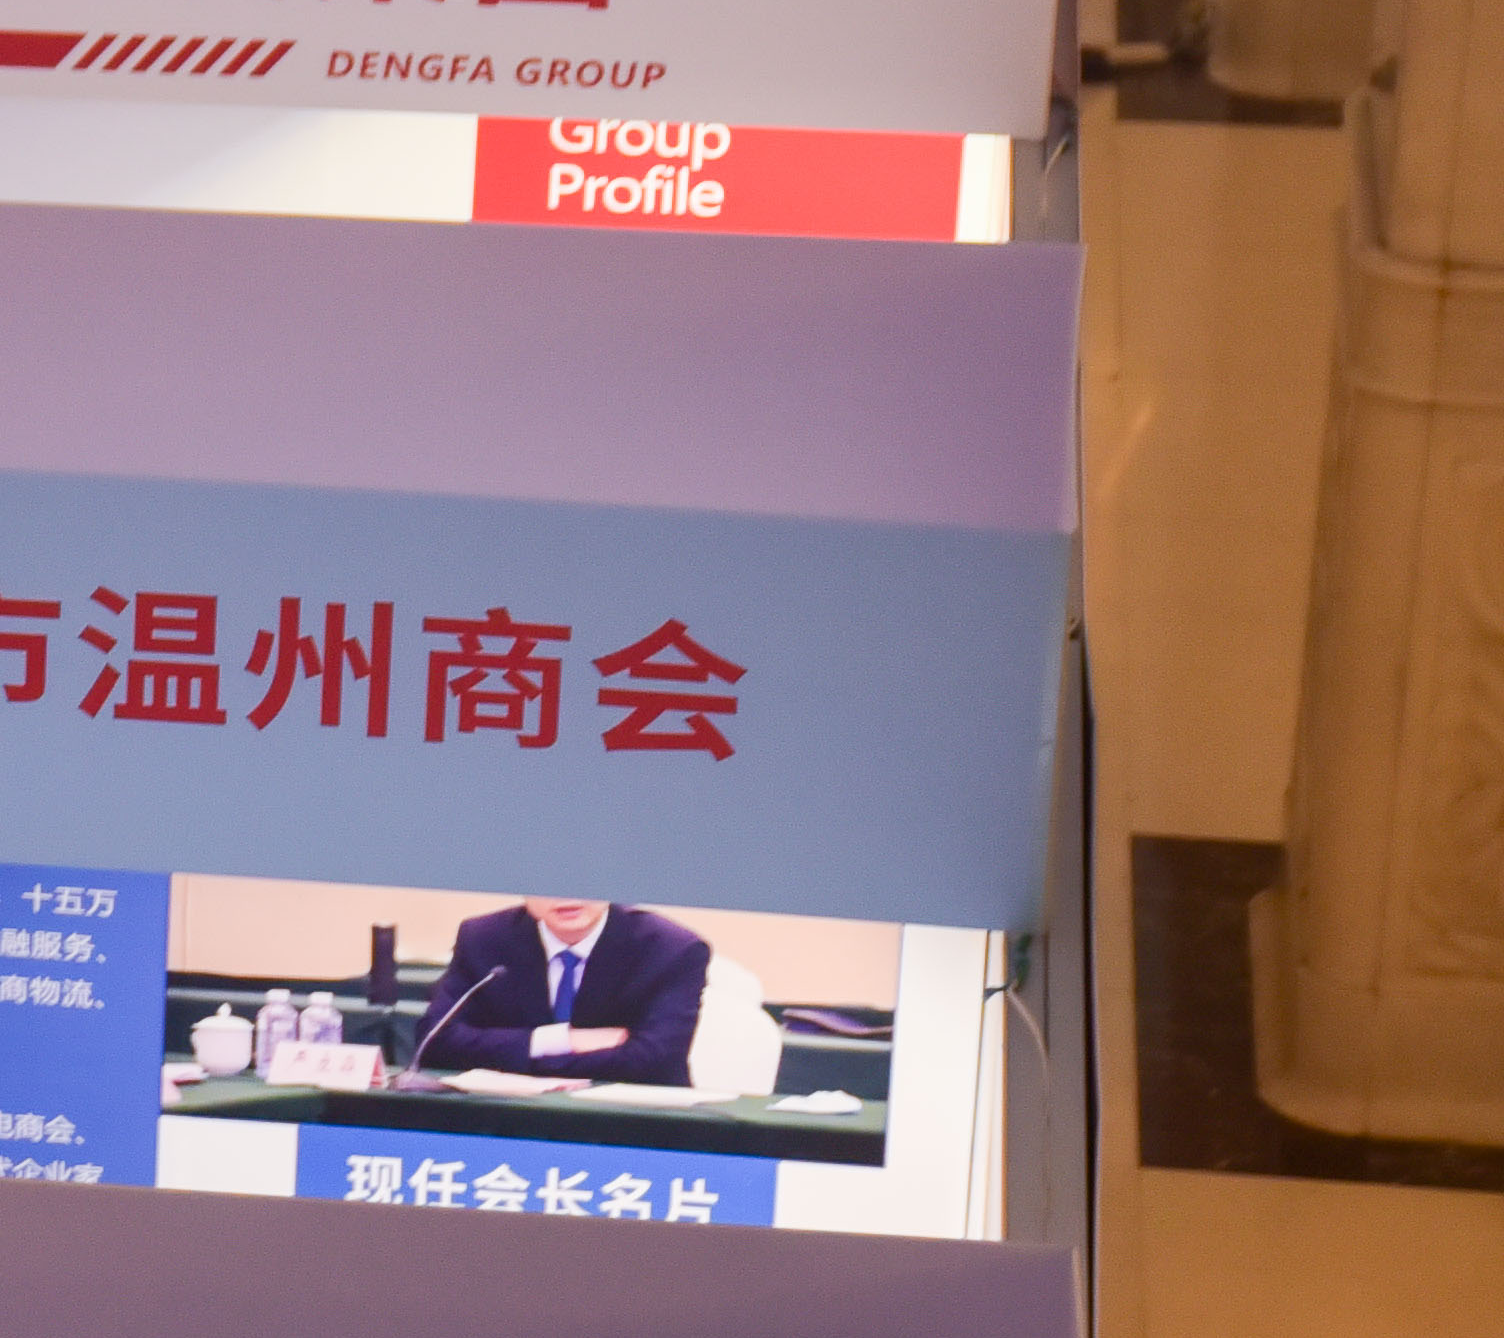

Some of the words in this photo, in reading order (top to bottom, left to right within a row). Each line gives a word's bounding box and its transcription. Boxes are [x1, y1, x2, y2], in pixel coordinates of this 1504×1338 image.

[325, 49, 496, 88] DENGFA
[515, 58, 668, 91] GROUP
[548, 117, 732, 172] Group
[547, 162, 725, 218] Profile
[344, 1154, 719, 1224] 现任会长名片
